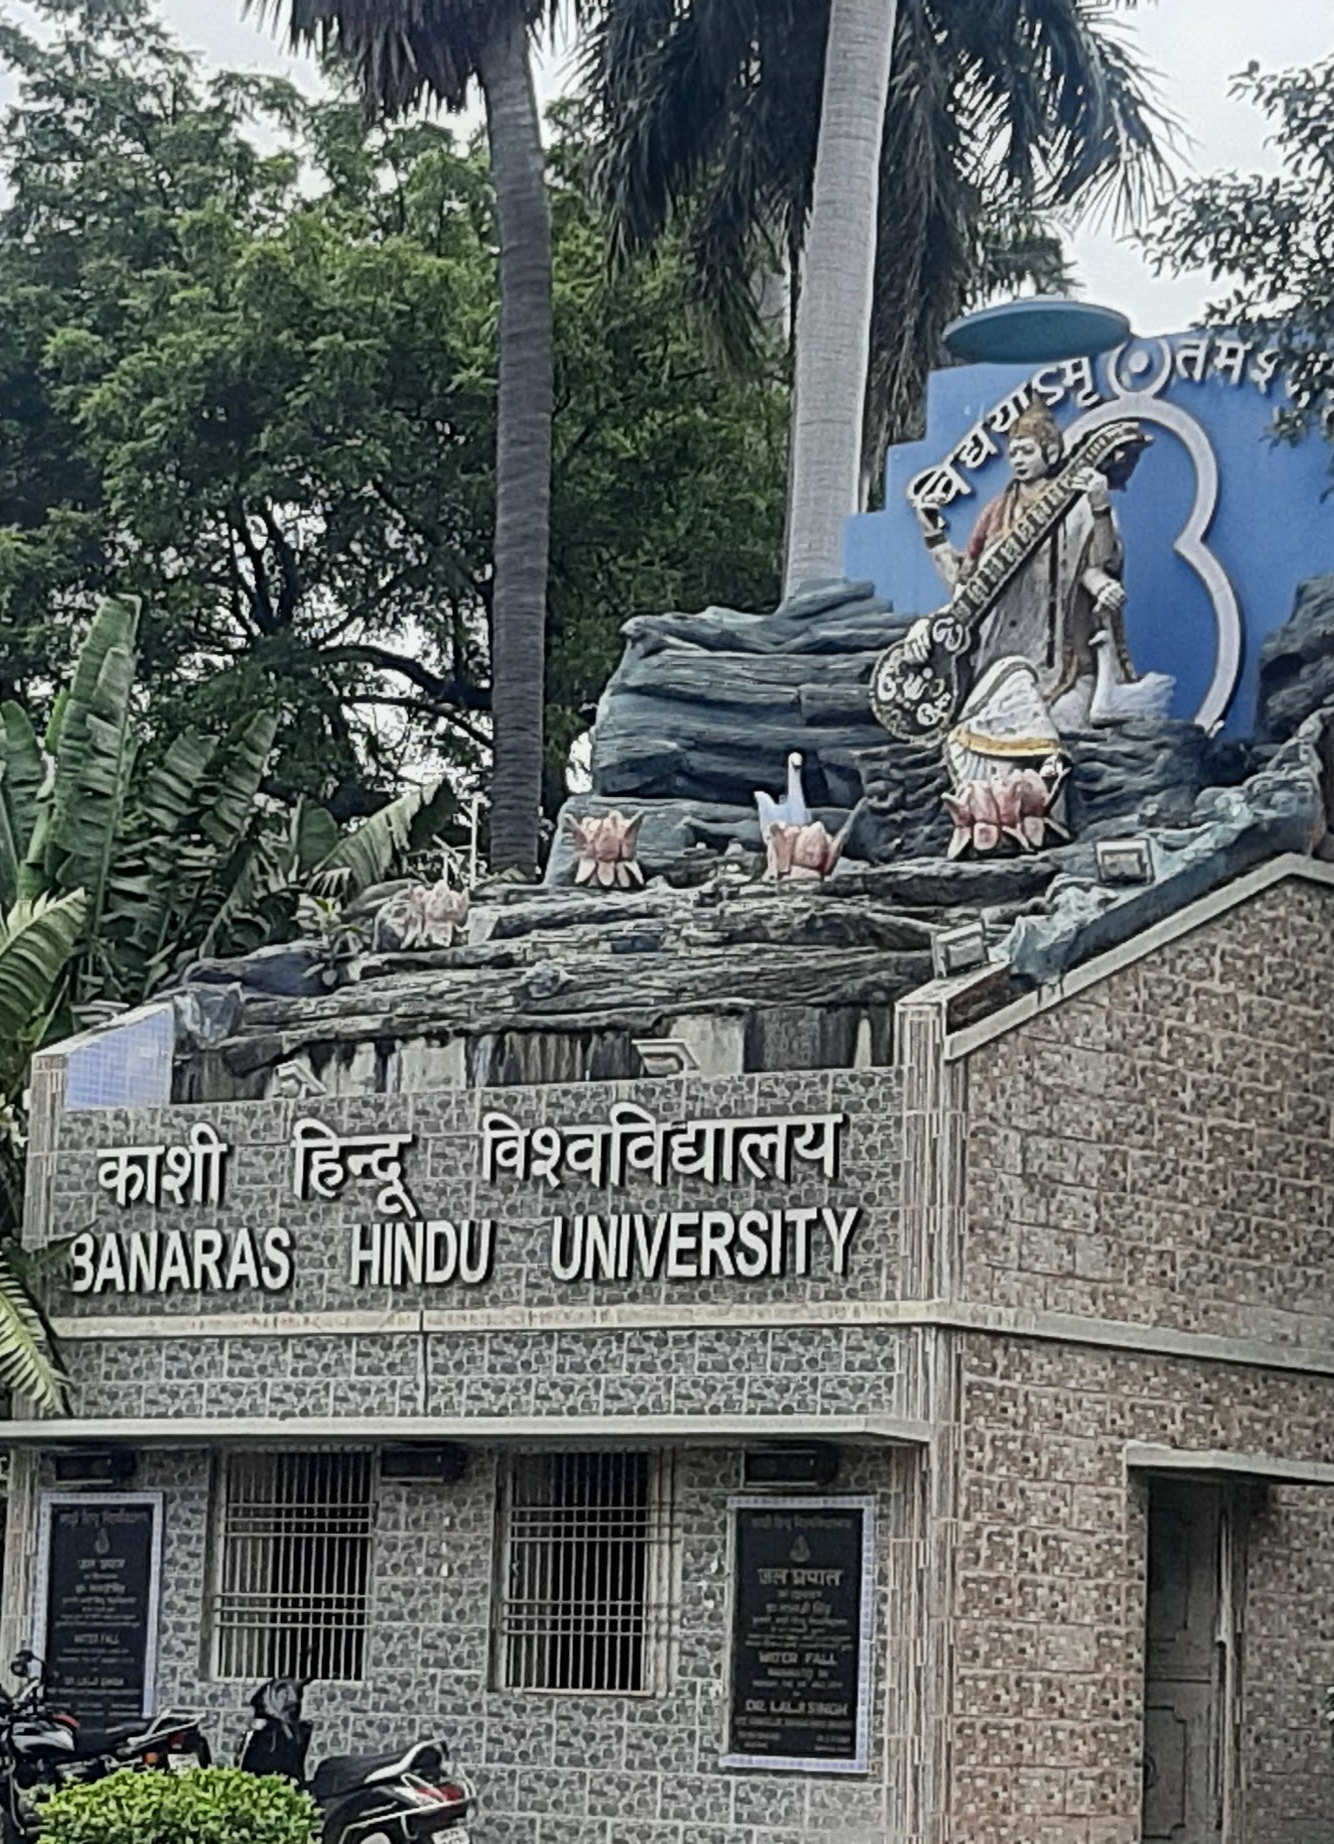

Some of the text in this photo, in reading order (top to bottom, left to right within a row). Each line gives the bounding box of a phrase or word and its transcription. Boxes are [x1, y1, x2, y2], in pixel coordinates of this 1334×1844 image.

[97, 1102, 845, 1218] काशी हिन्दू विश्वविद्यालय
[71, 1207, 860, 1293] BANARAS HINDU UNIVERSITY
